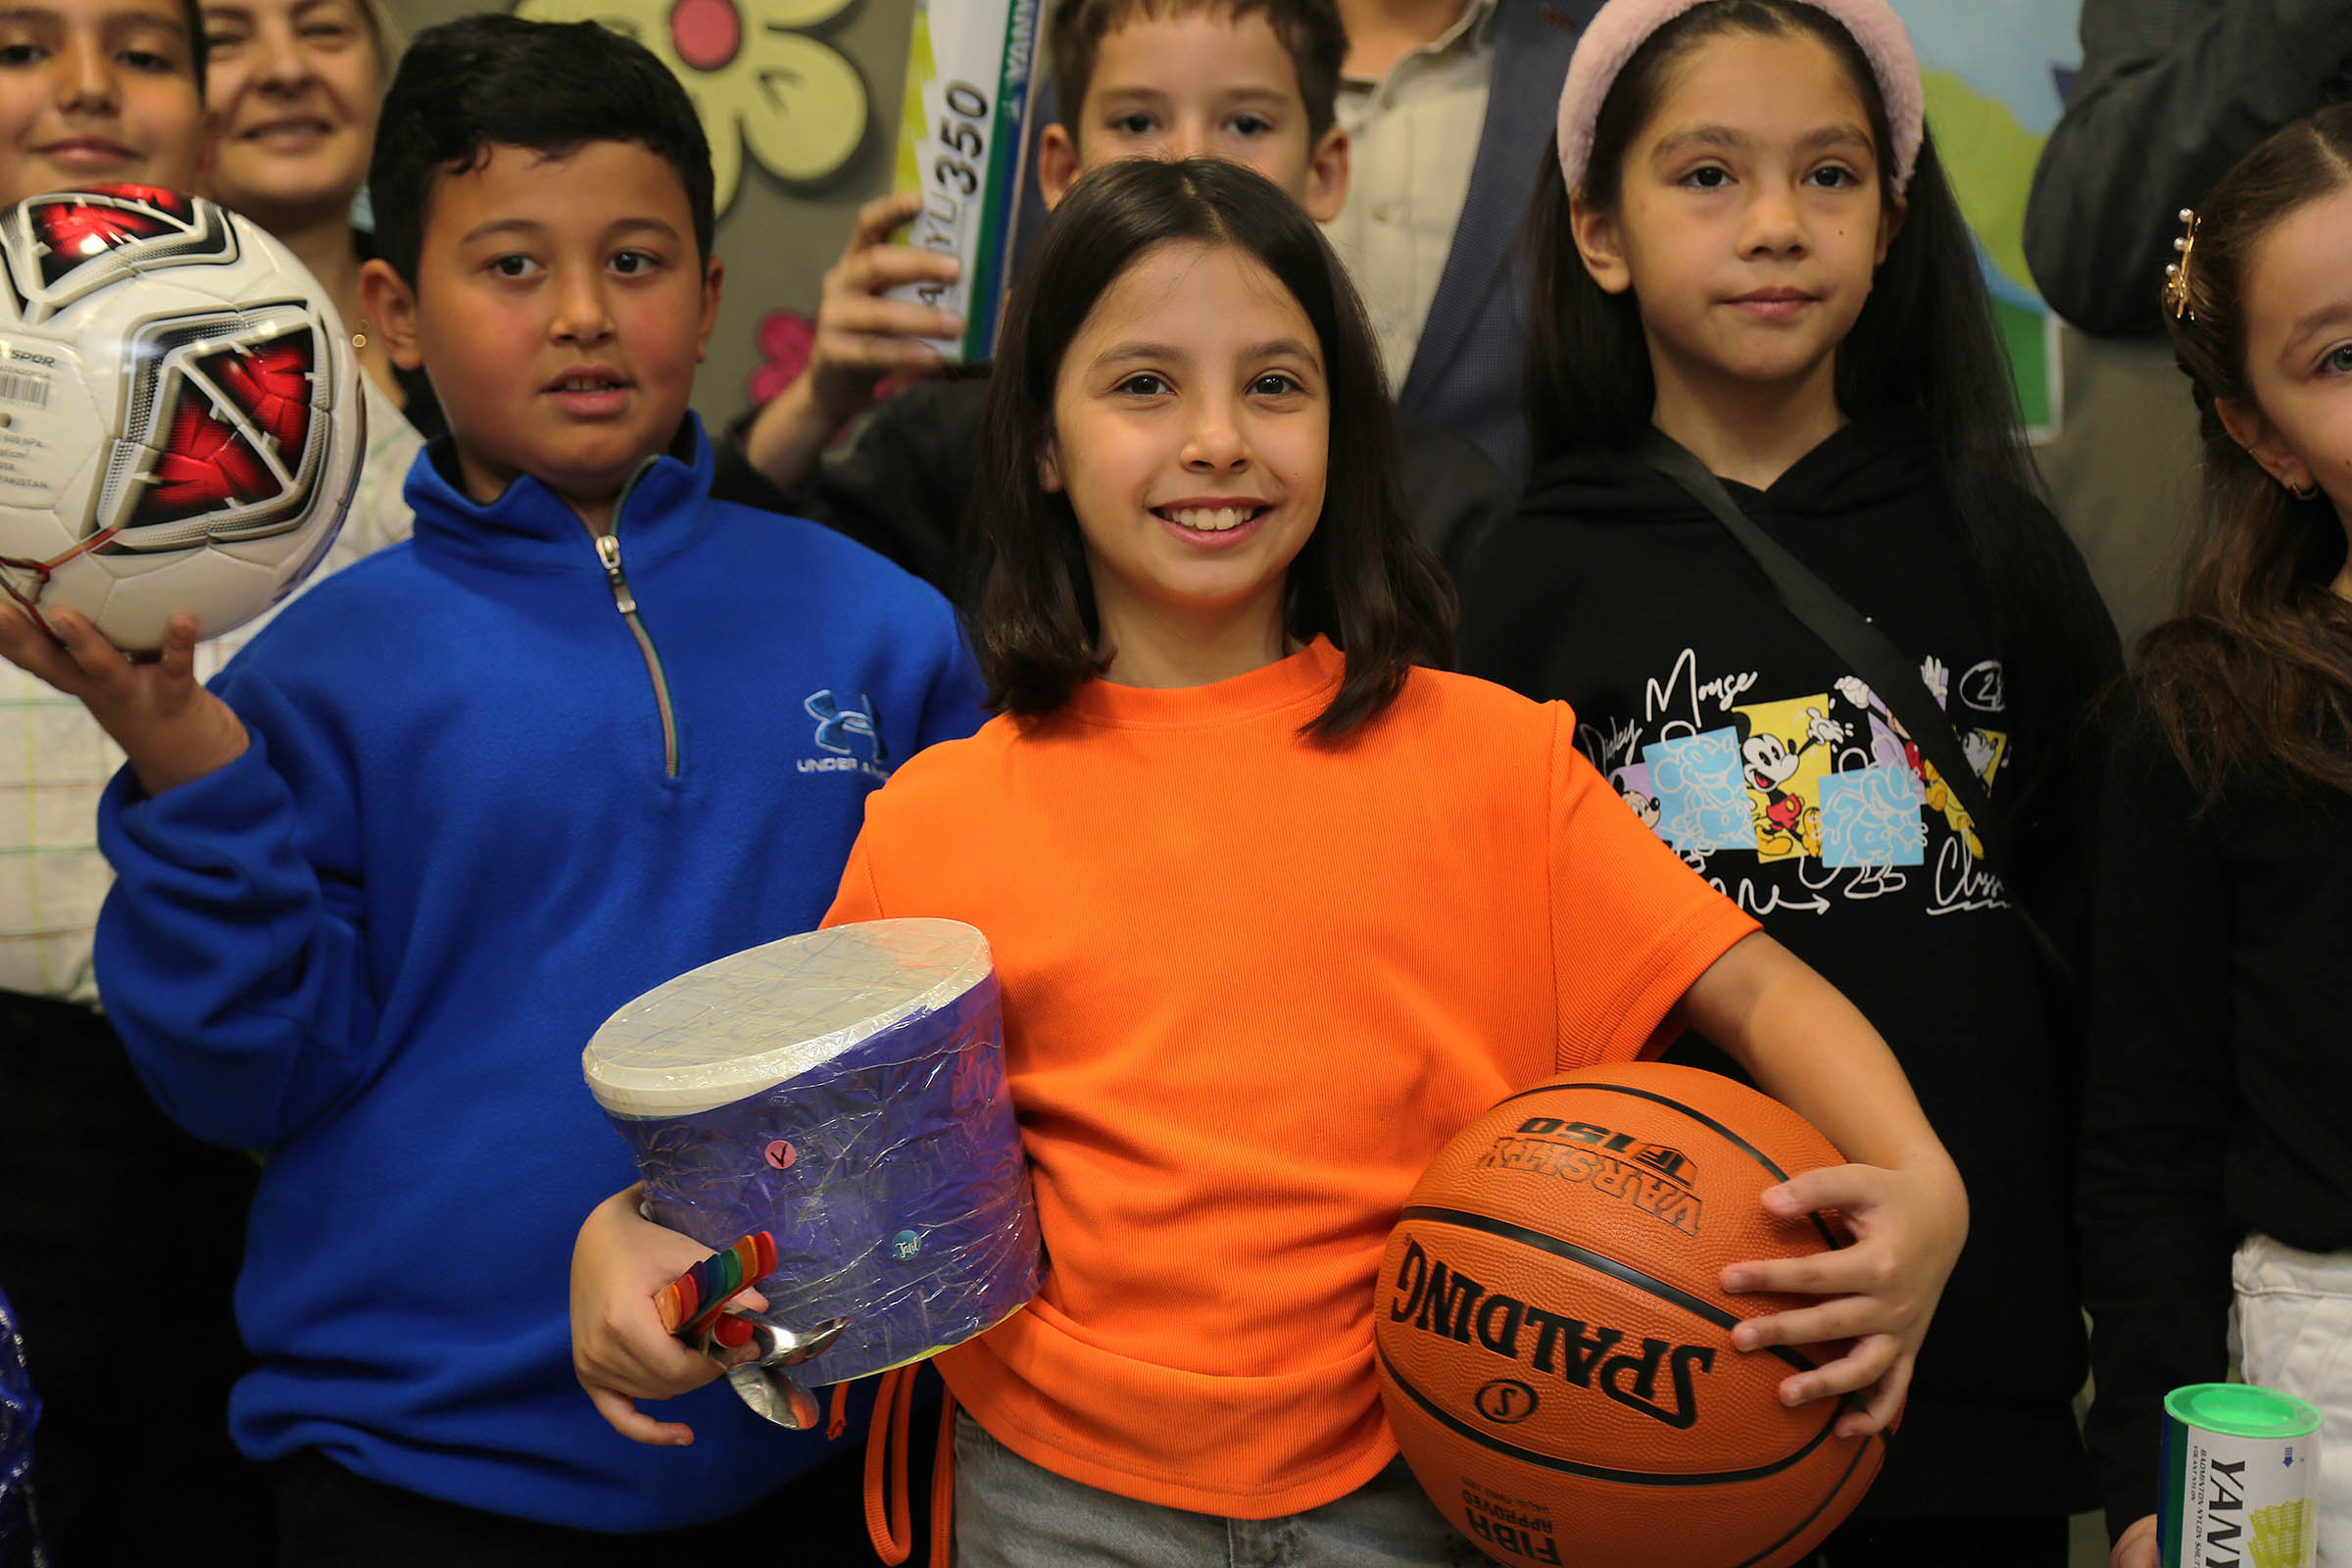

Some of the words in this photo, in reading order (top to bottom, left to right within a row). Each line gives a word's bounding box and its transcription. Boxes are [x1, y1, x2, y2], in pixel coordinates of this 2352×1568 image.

[937, 79, 989, 196] 350
[796, 757, 858, 773] UNDER
[1516, 1116, 1638, 1154] 150
[1475, 1136, 1703, 1239] VARSITY
[1391, 1239, 1717, 1431] SPALDING
[2196, 1448, 2207, 1506] BADMINTON
[1462, 1489, 1552, 1534] APPROVED
[1465, 1506, 1564, 1566] FIBA
[2194, 1508, 2204, 1540] NYLON
